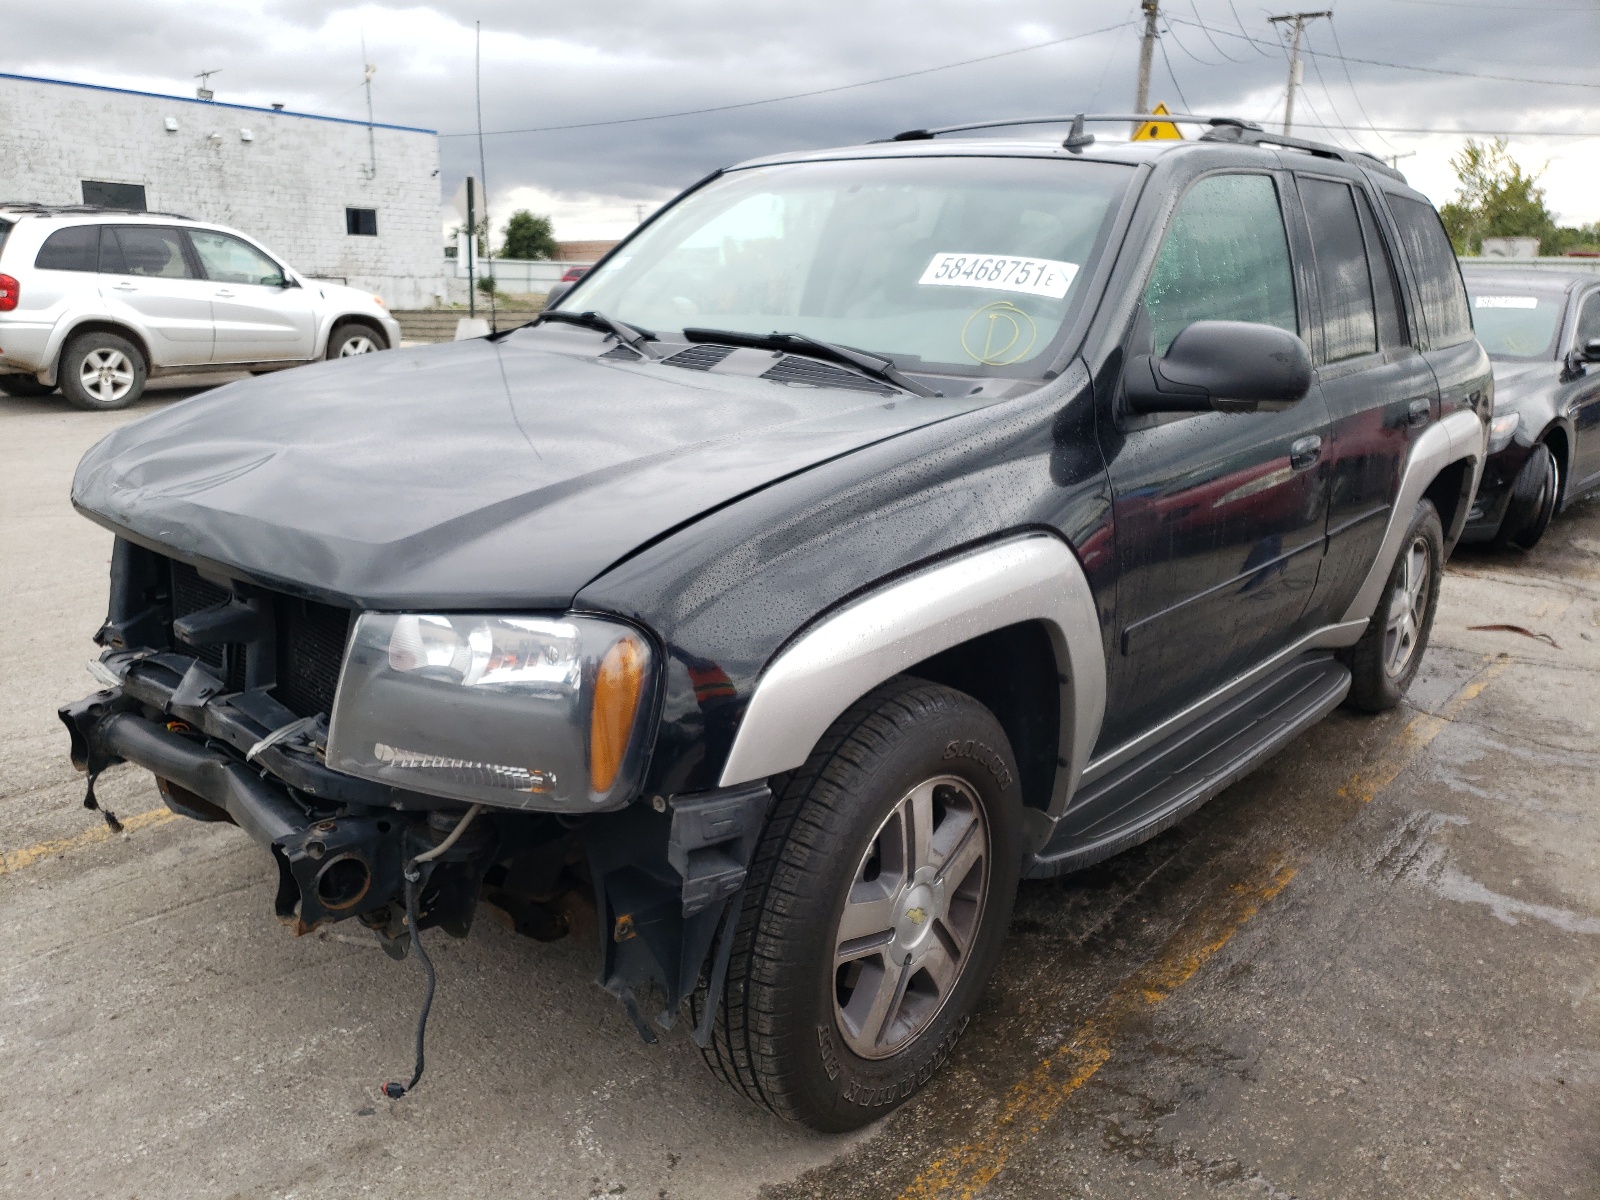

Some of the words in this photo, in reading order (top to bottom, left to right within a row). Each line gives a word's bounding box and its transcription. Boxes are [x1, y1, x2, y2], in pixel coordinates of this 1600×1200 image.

[935, 257, 1047, 286] 58468751
[983, 313, 1020, 361] D
[943, 739, 1012, 790] SAILUN
